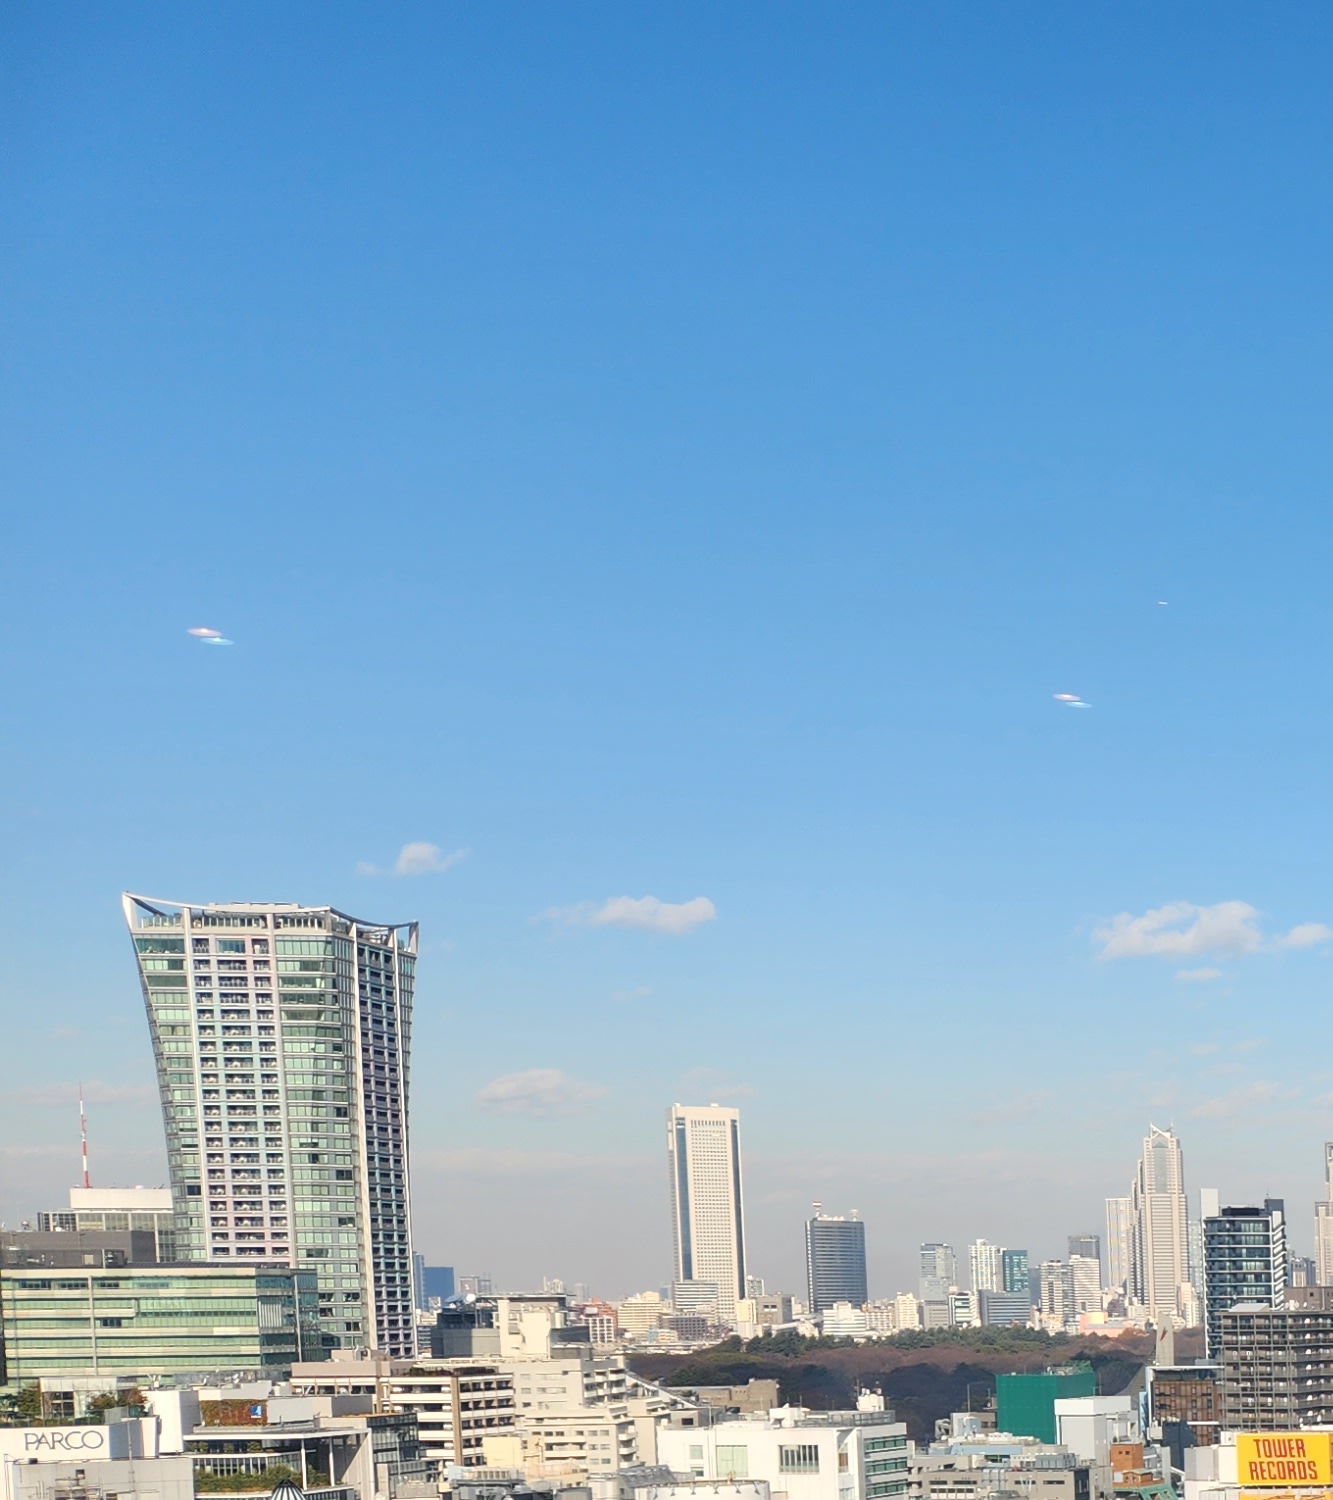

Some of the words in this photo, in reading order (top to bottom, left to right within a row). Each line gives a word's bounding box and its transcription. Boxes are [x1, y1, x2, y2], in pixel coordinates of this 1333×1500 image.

[24, 1430, 104, 1451] PARCO
[1253, 1438, 1306, 1458] TOWER
[1249, 1461, 1318, 1480] RECORDS
